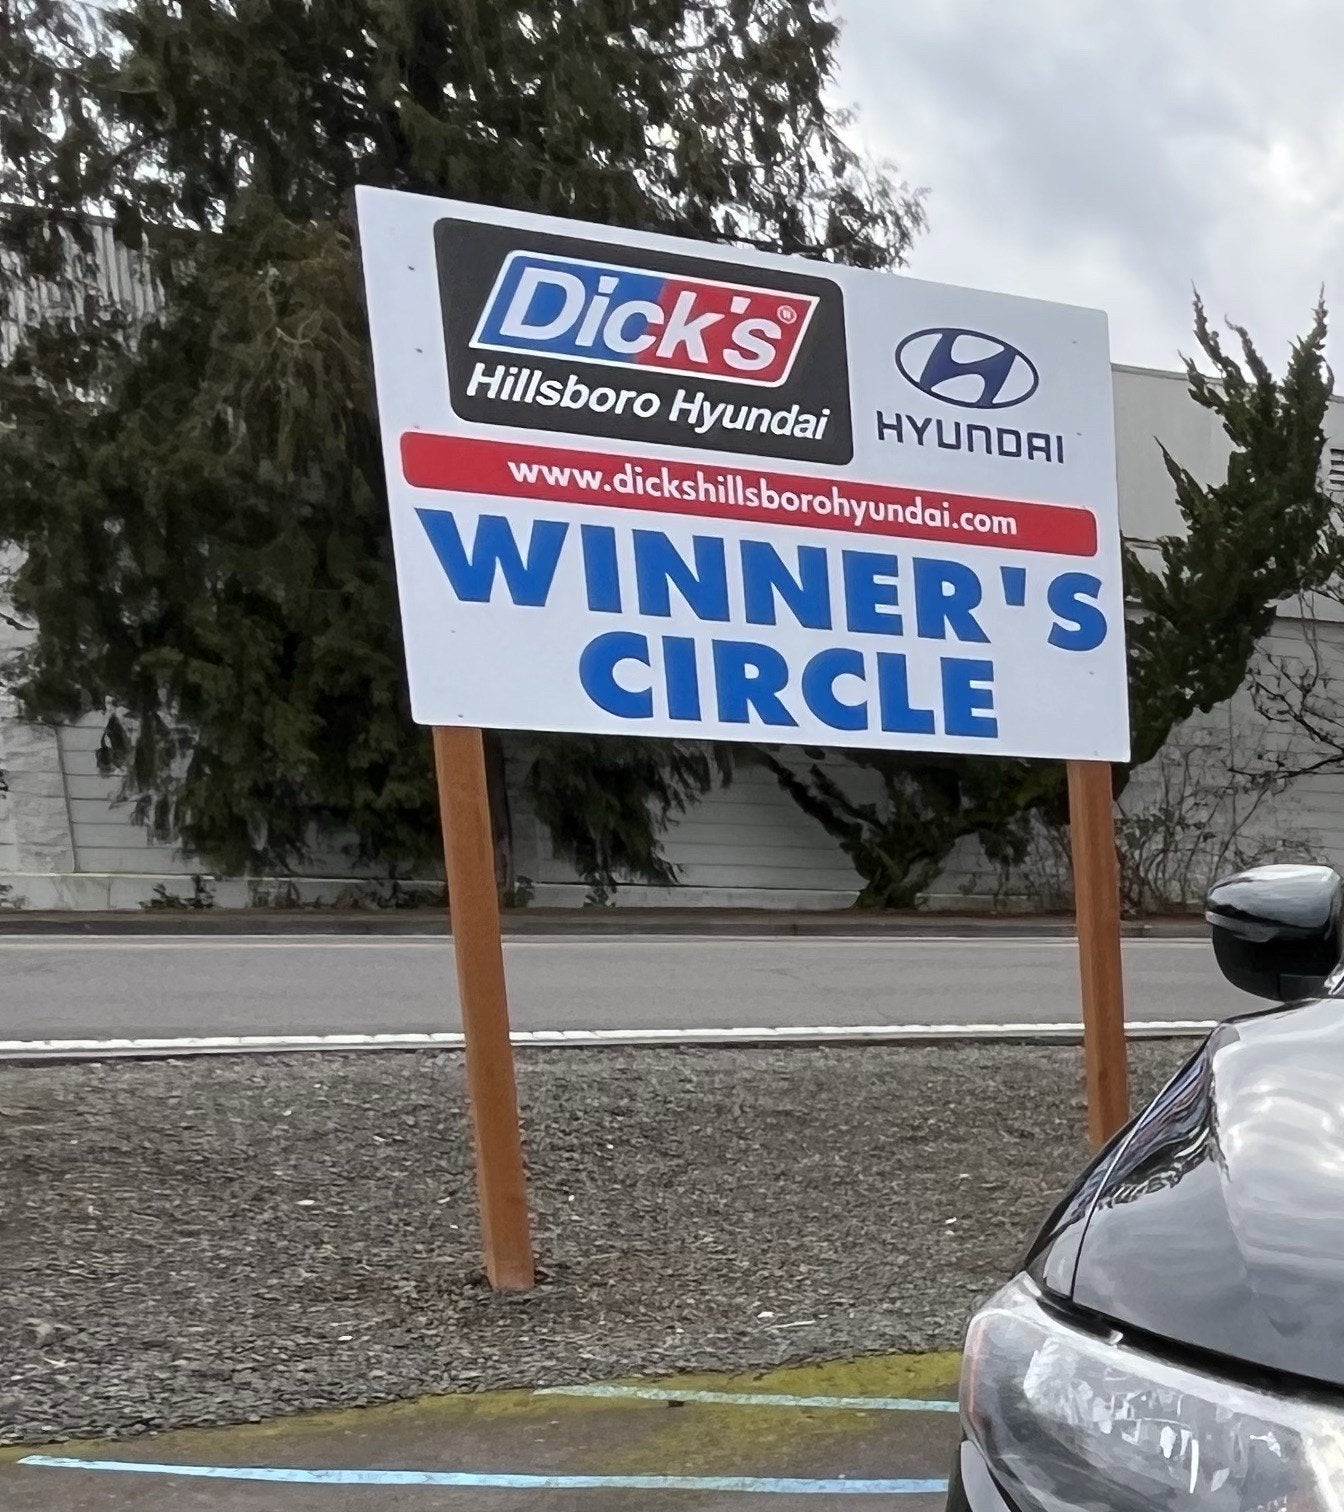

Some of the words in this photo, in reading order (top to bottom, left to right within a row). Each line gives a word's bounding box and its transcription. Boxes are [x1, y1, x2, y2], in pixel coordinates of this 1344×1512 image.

[499, 266, 784, 372] Dick's
[467, 363, 660, 418] Hillsboro
[669, 388, 831, 441] Hyundai
[877, 411, 1064, 464] HYUNDAI
[508, 458, 1018, 536] www.dickshillsborohyundai.com
[415, 507, 1108, 651] WINNER'S
[578, 632, 999, 738] CIRCLE
